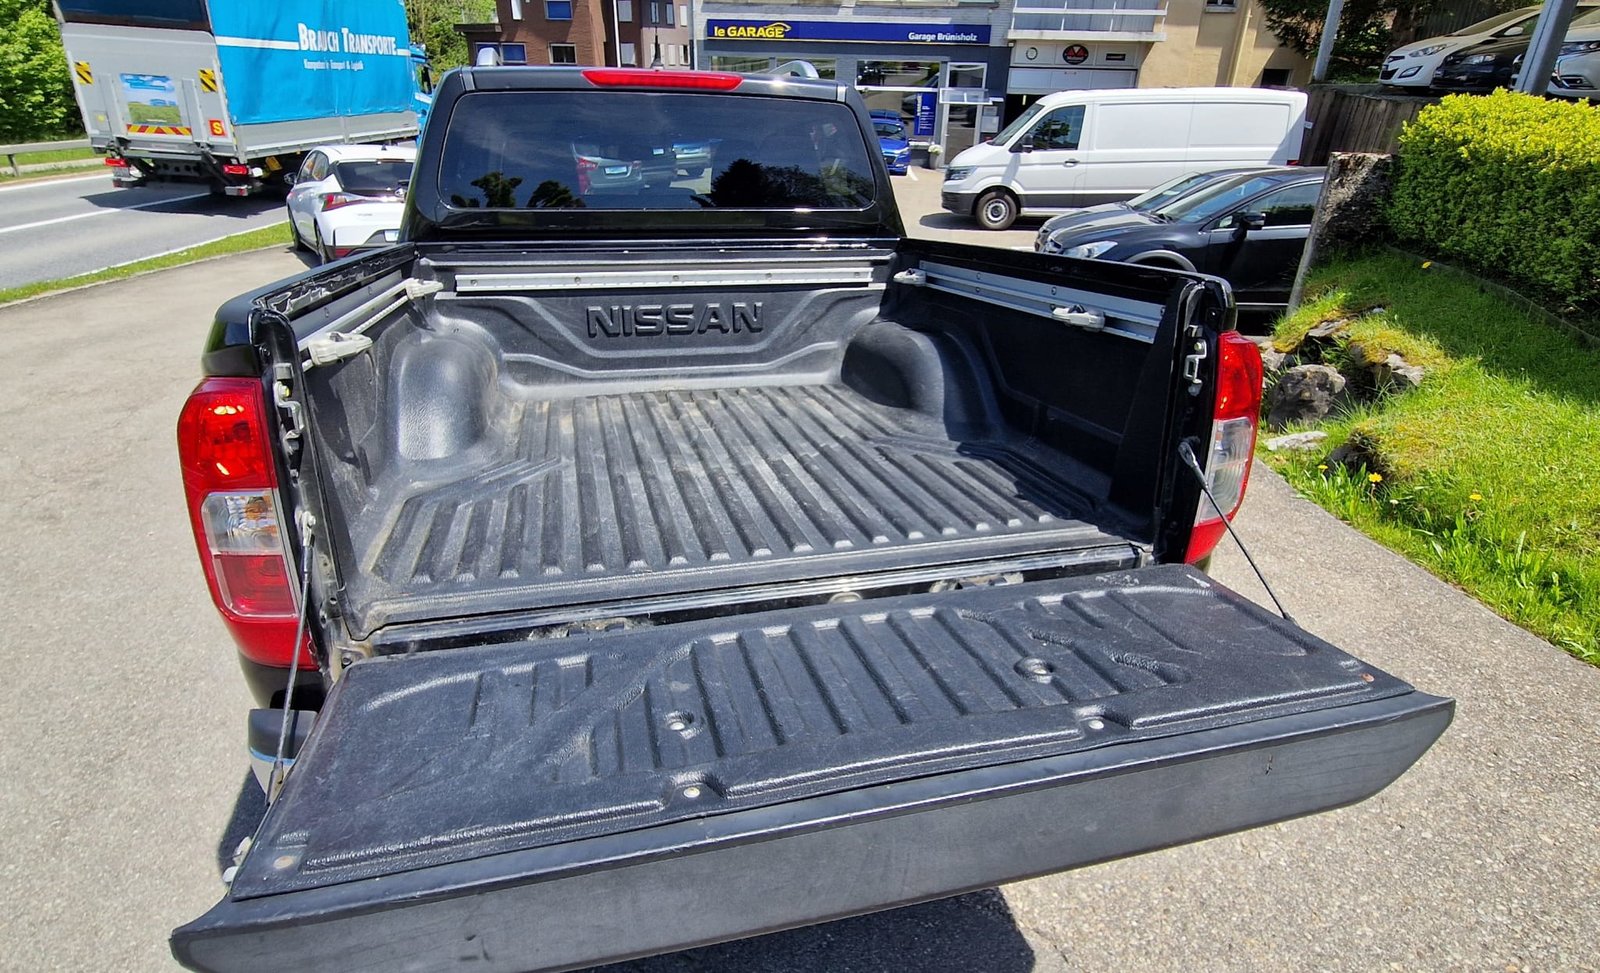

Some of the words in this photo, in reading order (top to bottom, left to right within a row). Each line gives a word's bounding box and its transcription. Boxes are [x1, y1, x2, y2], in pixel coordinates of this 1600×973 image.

[298, 22, 339, 52] BRAUCH
[341, 27, 397, 55] TRANSPORTE
[714, 26, 725, 37] le
[727, 26, 785, 38] GARAGE
[908, 32, 936, 42] Garage
[937, 32, 978, 41] Brünisholz
[212, 122, 223, 135] S
[586, 302, 763, 338] NISSAN
